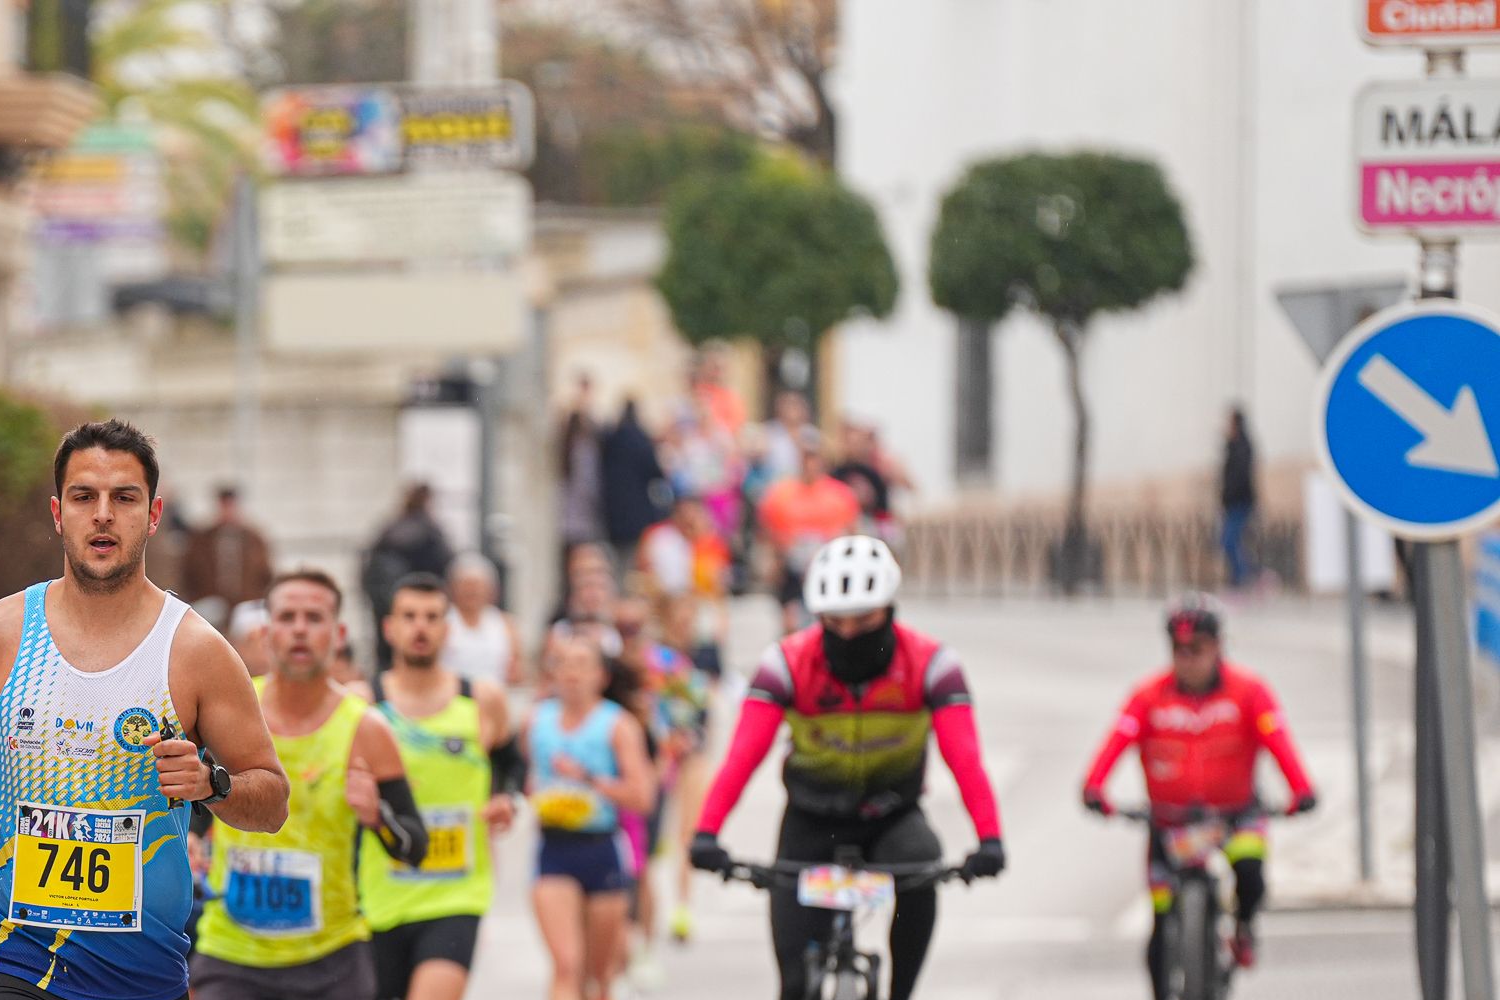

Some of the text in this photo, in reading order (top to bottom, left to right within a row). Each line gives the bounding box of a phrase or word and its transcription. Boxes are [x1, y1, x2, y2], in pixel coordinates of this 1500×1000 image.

[1381, 0, 1496, 30] Ciudad
[31, 809, 70, 839] 21K
[38, 843, 111, 893] 746
